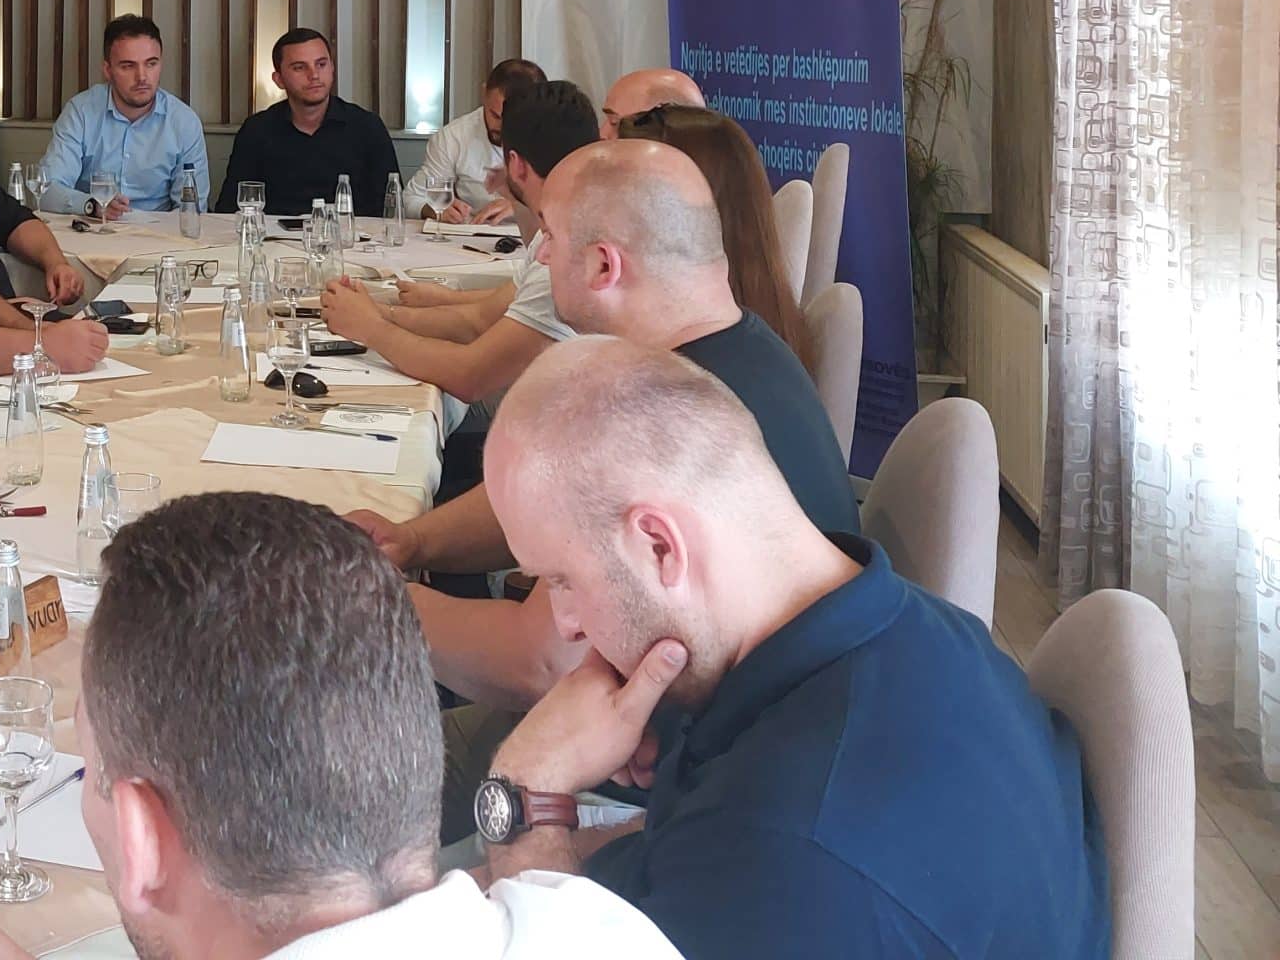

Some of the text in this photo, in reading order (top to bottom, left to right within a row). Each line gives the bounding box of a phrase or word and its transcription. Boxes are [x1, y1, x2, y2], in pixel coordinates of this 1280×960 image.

[681, 41, 713, 80] Ngritja
[792, 48, 869, 89] bashkëpunim
[764, 99, 786, 125] mes
[789, 95, 868, 131] institucioneve
